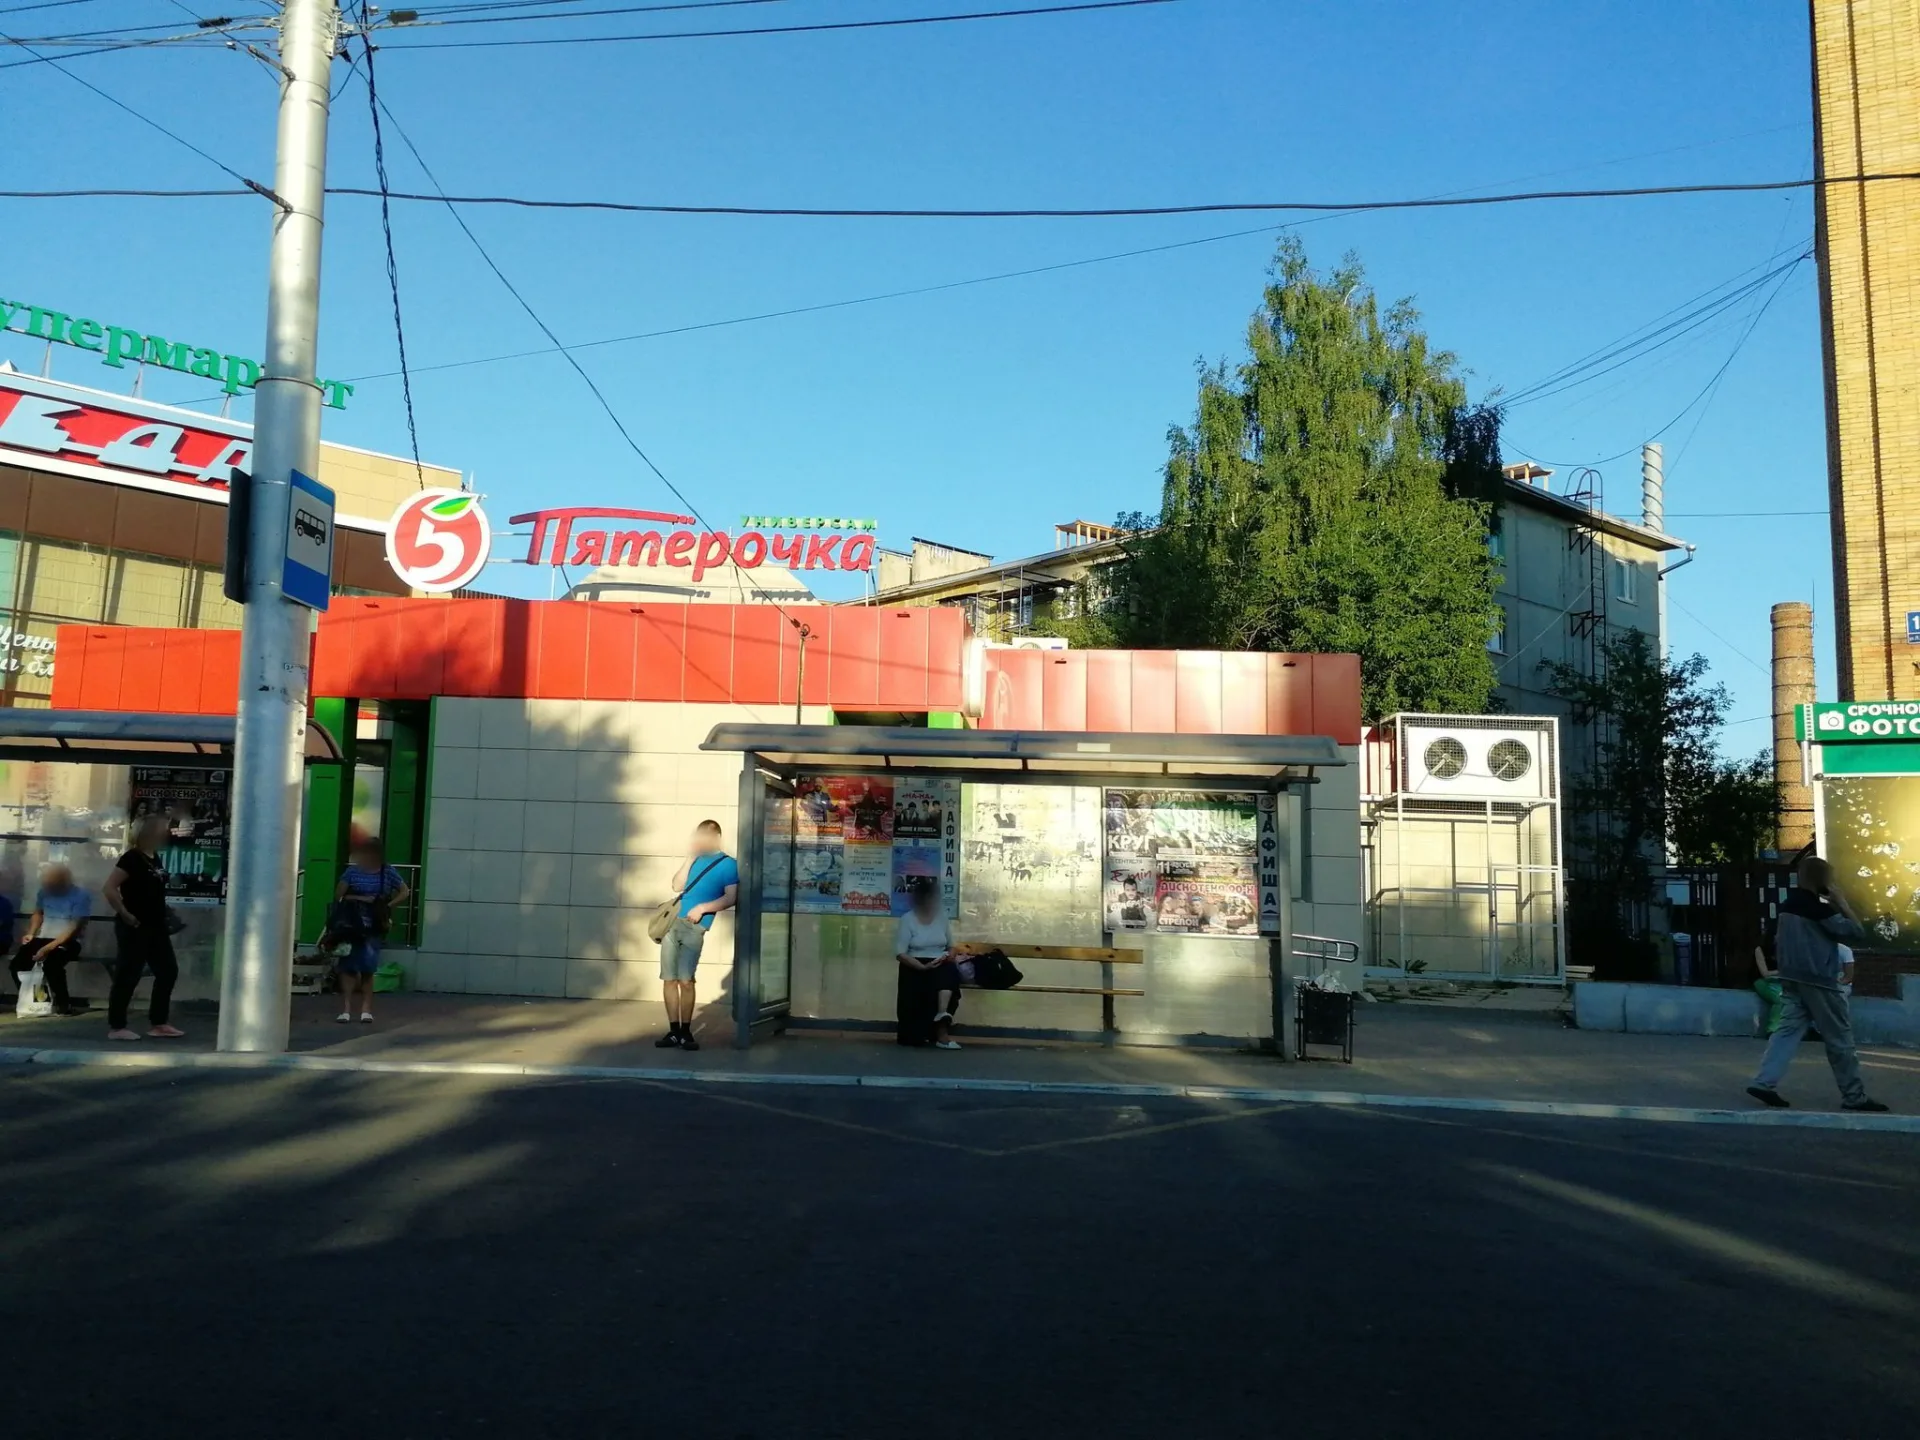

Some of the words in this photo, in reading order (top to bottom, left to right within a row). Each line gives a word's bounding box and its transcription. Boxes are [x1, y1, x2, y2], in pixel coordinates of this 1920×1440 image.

[0, 297, 354, 410] упермарт
[742, 515, 877, 530] УНИВЕРСАМ
[509, 507, 876, 582] Пятёрочка
[1847, 703, 1920, 716] СРОЧНО
[136, 769, 147, 781] 11
[945, 811, 955, 877] АФИША
[1108, 834, 1154, 851] КРУГ
[1157, 861, 1170, 874] 11
[1261, 820, 1277, 906] АФИША
[1110, 867, 1152, 883] Emin
